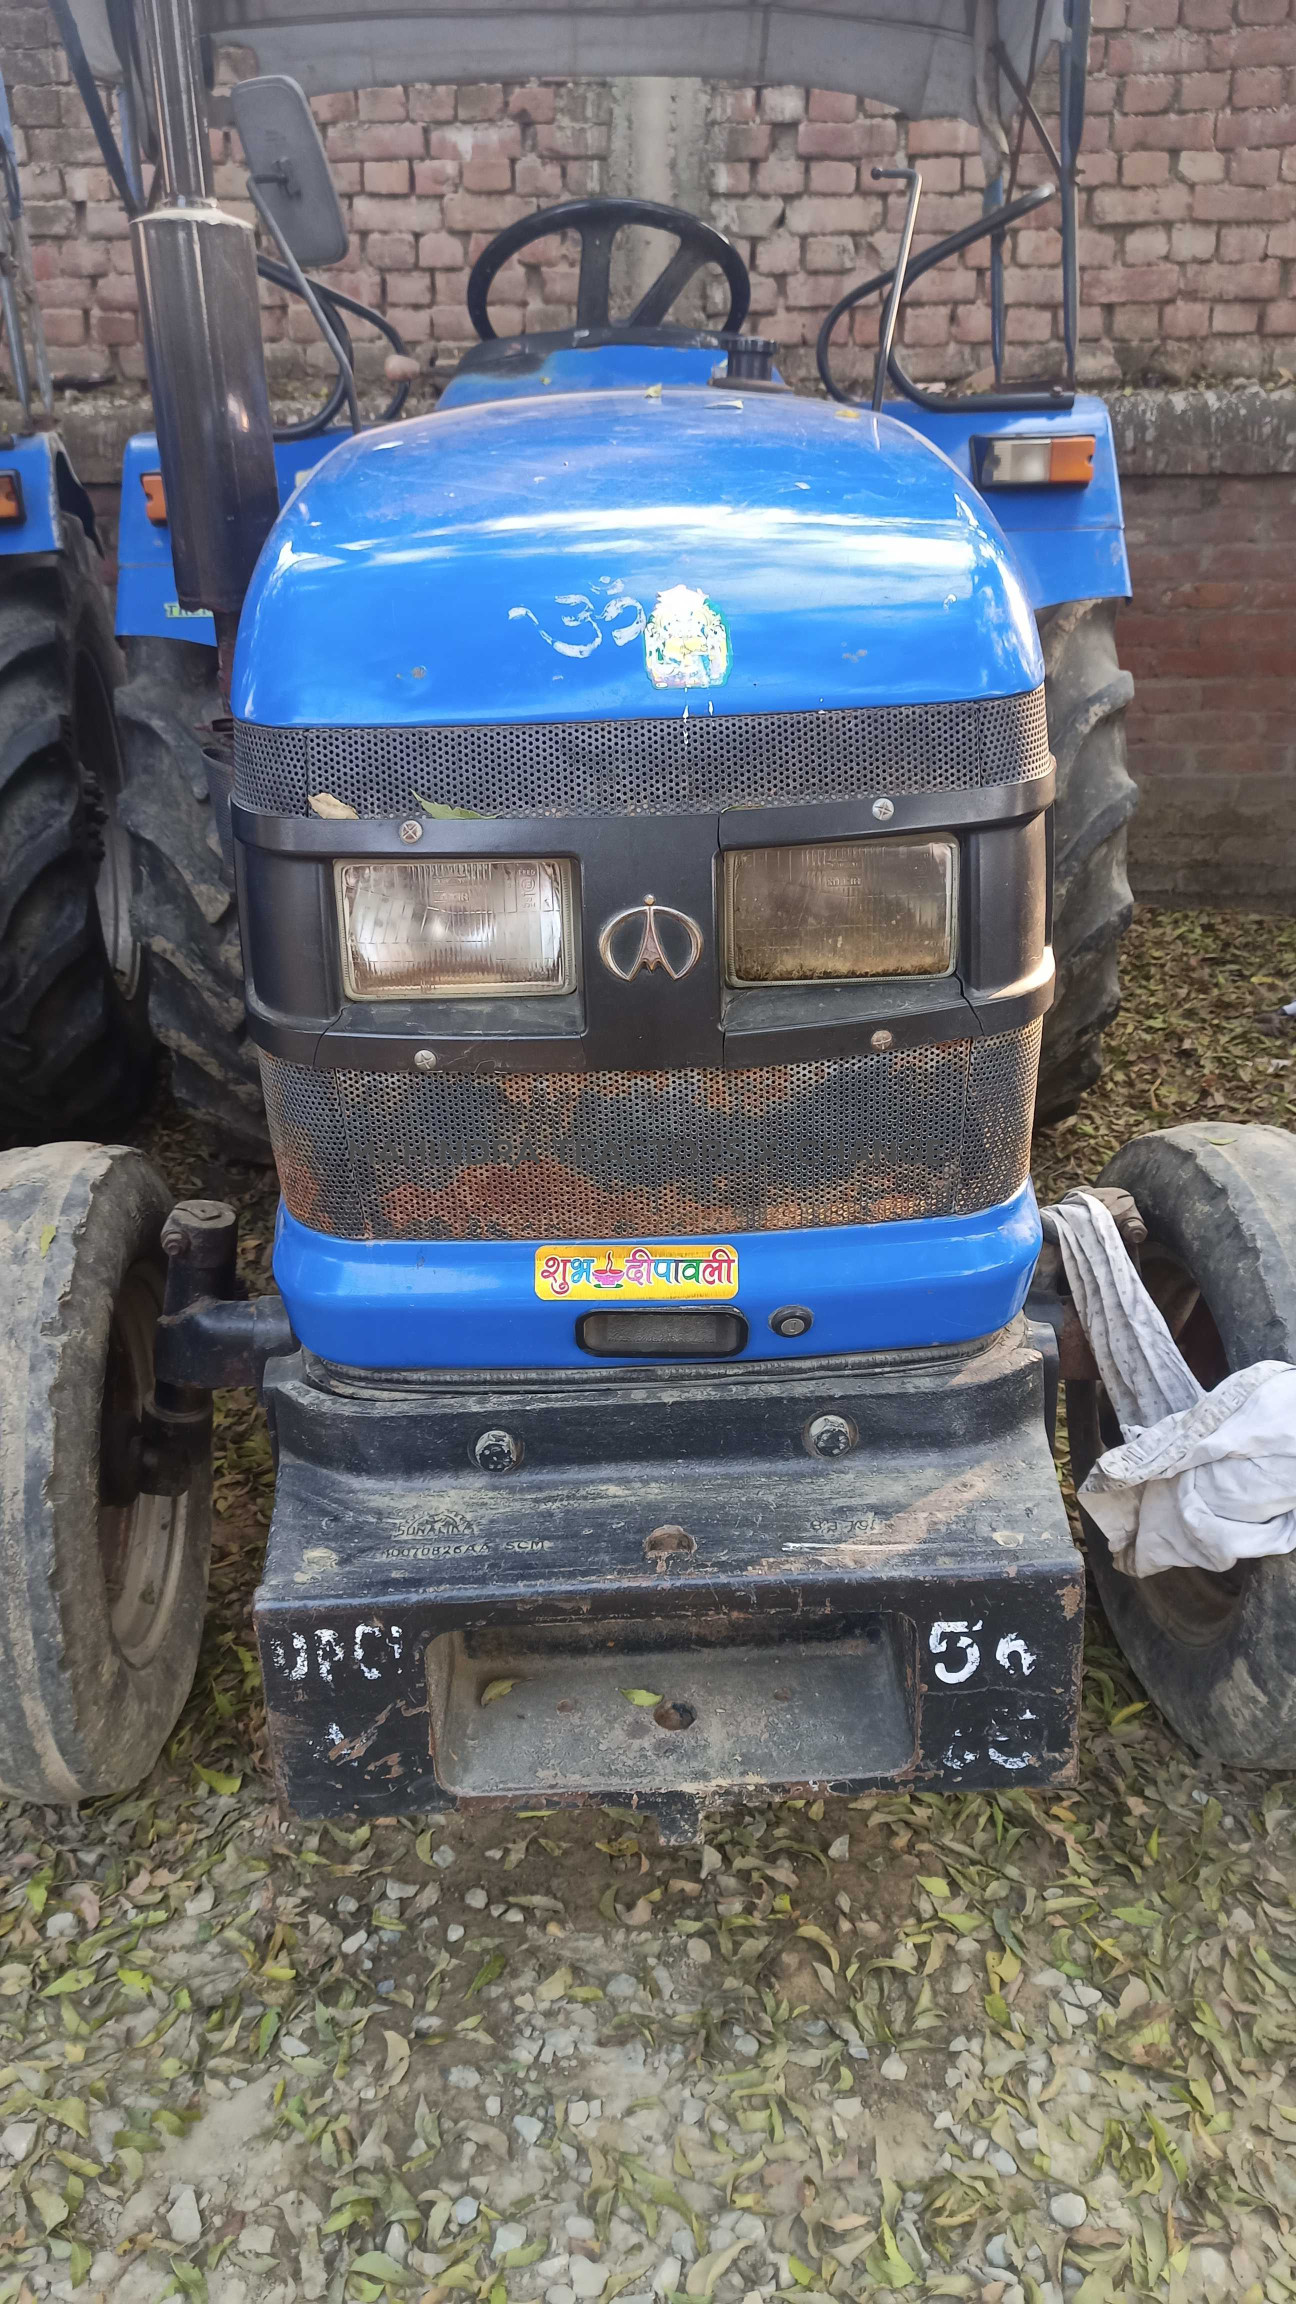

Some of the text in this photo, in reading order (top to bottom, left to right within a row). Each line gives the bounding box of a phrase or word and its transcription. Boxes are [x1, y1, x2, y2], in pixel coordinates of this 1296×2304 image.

[541, 1248, 736, 1295] शुभ दीपावली
[504, 1539, 545, 1551] SCM
